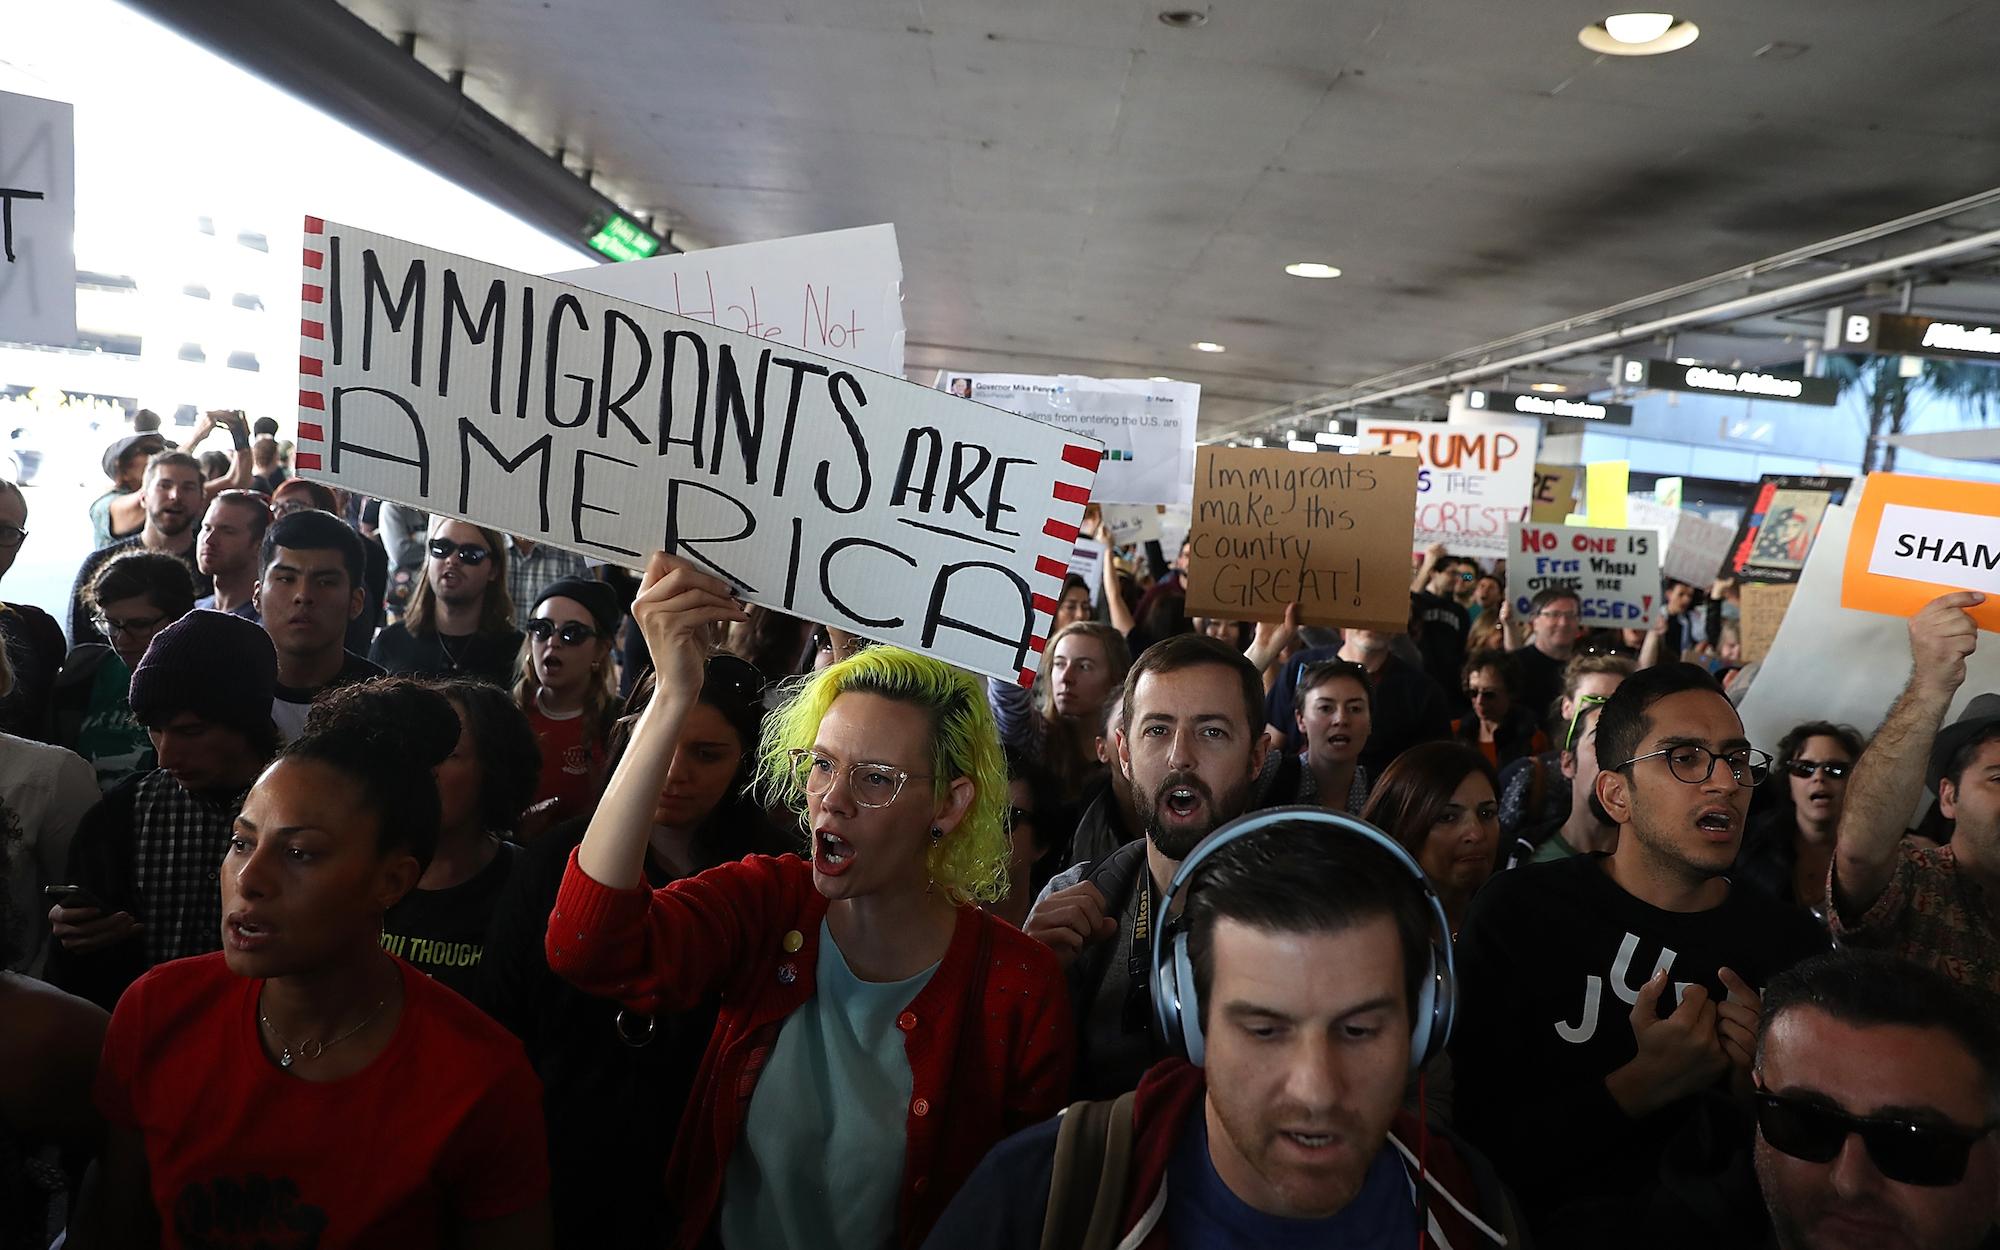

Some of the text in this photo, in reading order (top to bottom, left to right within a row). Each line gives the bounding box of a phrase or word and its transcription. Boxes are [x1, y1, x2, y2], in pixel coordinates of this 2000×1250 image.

[802, 283, 866, 349] Not
[1846, 315, 1870, 343] B
[330, 235, 1038, 537] IMMIGRANTS ARE
[1625, 360, 1643, 382] B
[1055, 413, 1078, 424] from
[1080, 415, 1119, 427] entering
[1121, 416, 1137, 425] the
[1139, 417, 1160, 427] U.S.
[1163, 419, 1178, 427] are
[1368, 427, 1518, 472] TRUMP
[1208, 453, 1377, 513] Immigrants
[1417, 470, 1486, 496] S THE
[330, 386, 1036, 672] AMERICA
[1200, 492, 1355, 530] make this
[1193, 530, 1311, 571] country
[1520, 528, 1558, 554] NO
[1572, 533, 1617, 554] ONE
[1628, 535, 1649, 556] IS
[1212, 557, 1362, 608] GREAT!
[1516, 595, 1654, 623] OSSED!
[1135, 889, 1148, 940] Nikon
